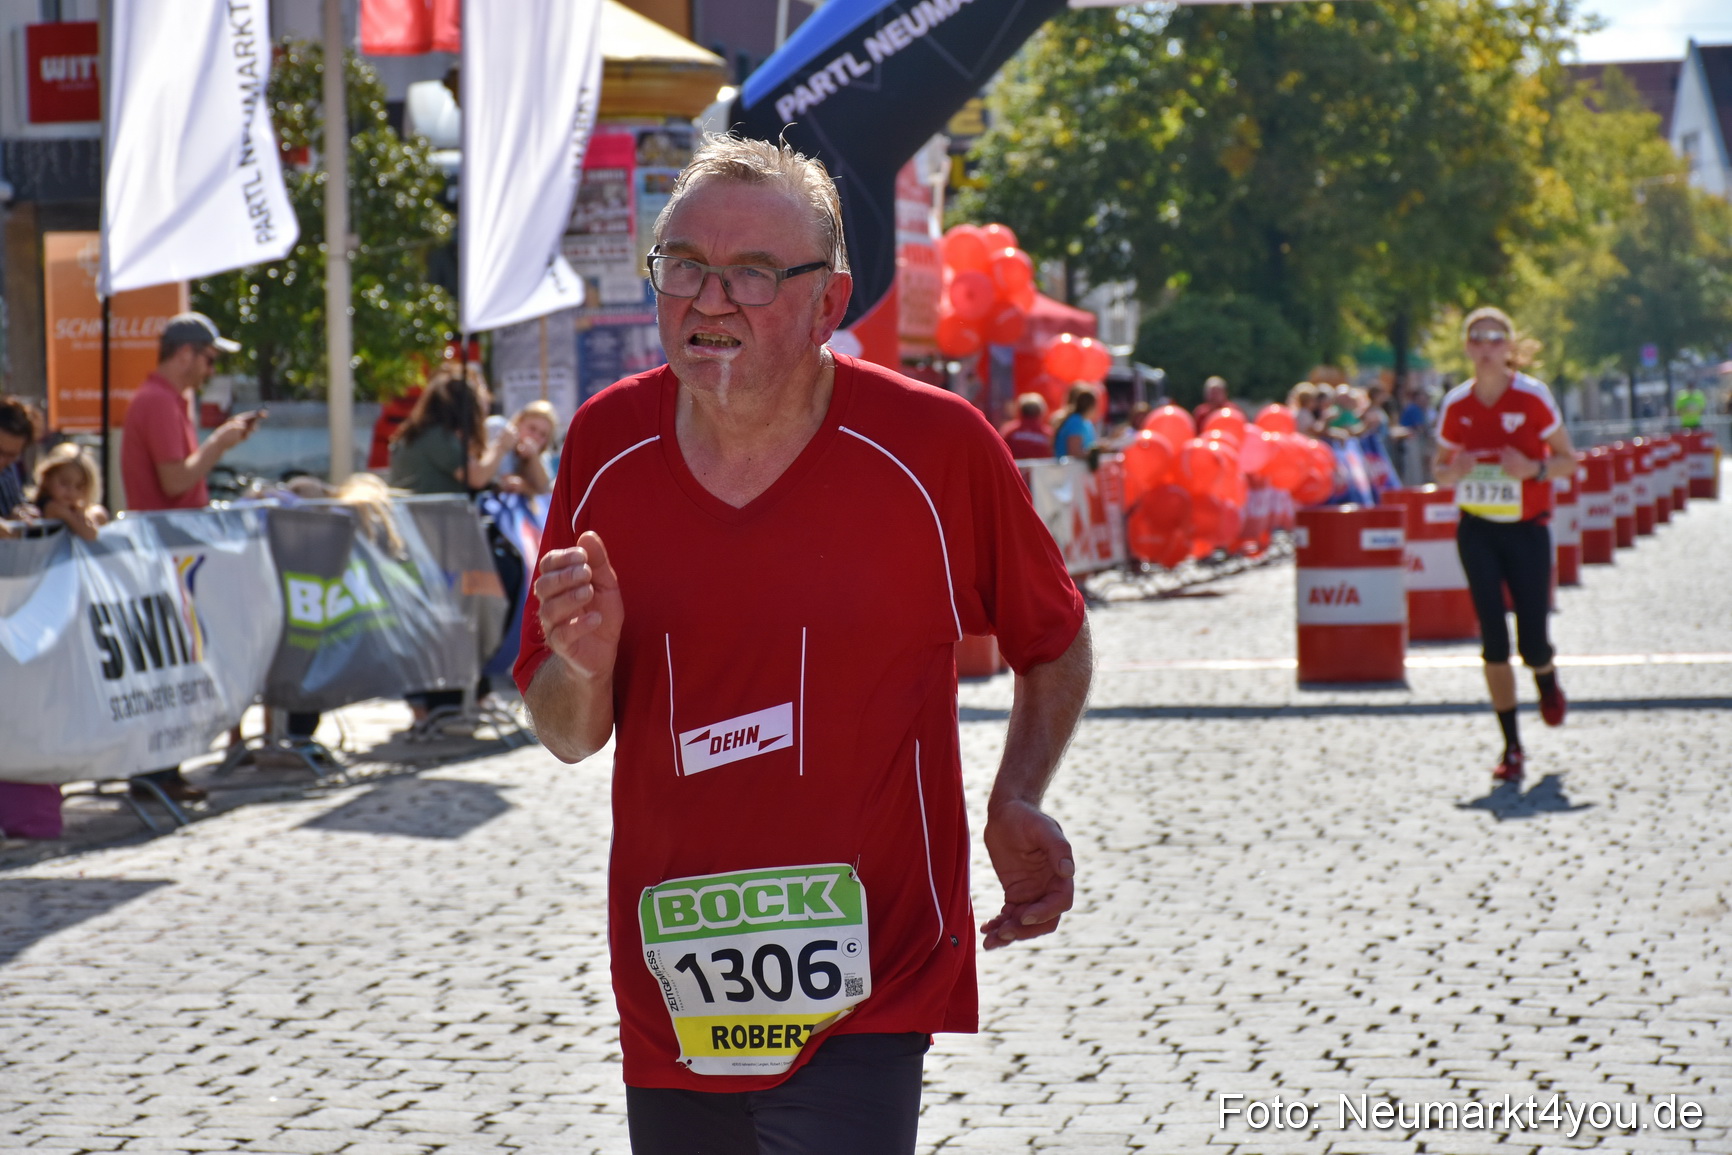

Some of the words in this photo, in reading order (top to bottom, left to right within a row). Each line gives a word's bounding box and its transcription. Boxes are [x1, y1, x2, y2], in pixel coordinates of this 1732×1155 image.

[775, 51, 872, 123] PARTL
[240, 169, 277, 246] PARTL
[709, 724, 760, 756] DEHN
[655, 874, 845, 934] BOCK
[674, 939, 842, 1003] 1306
